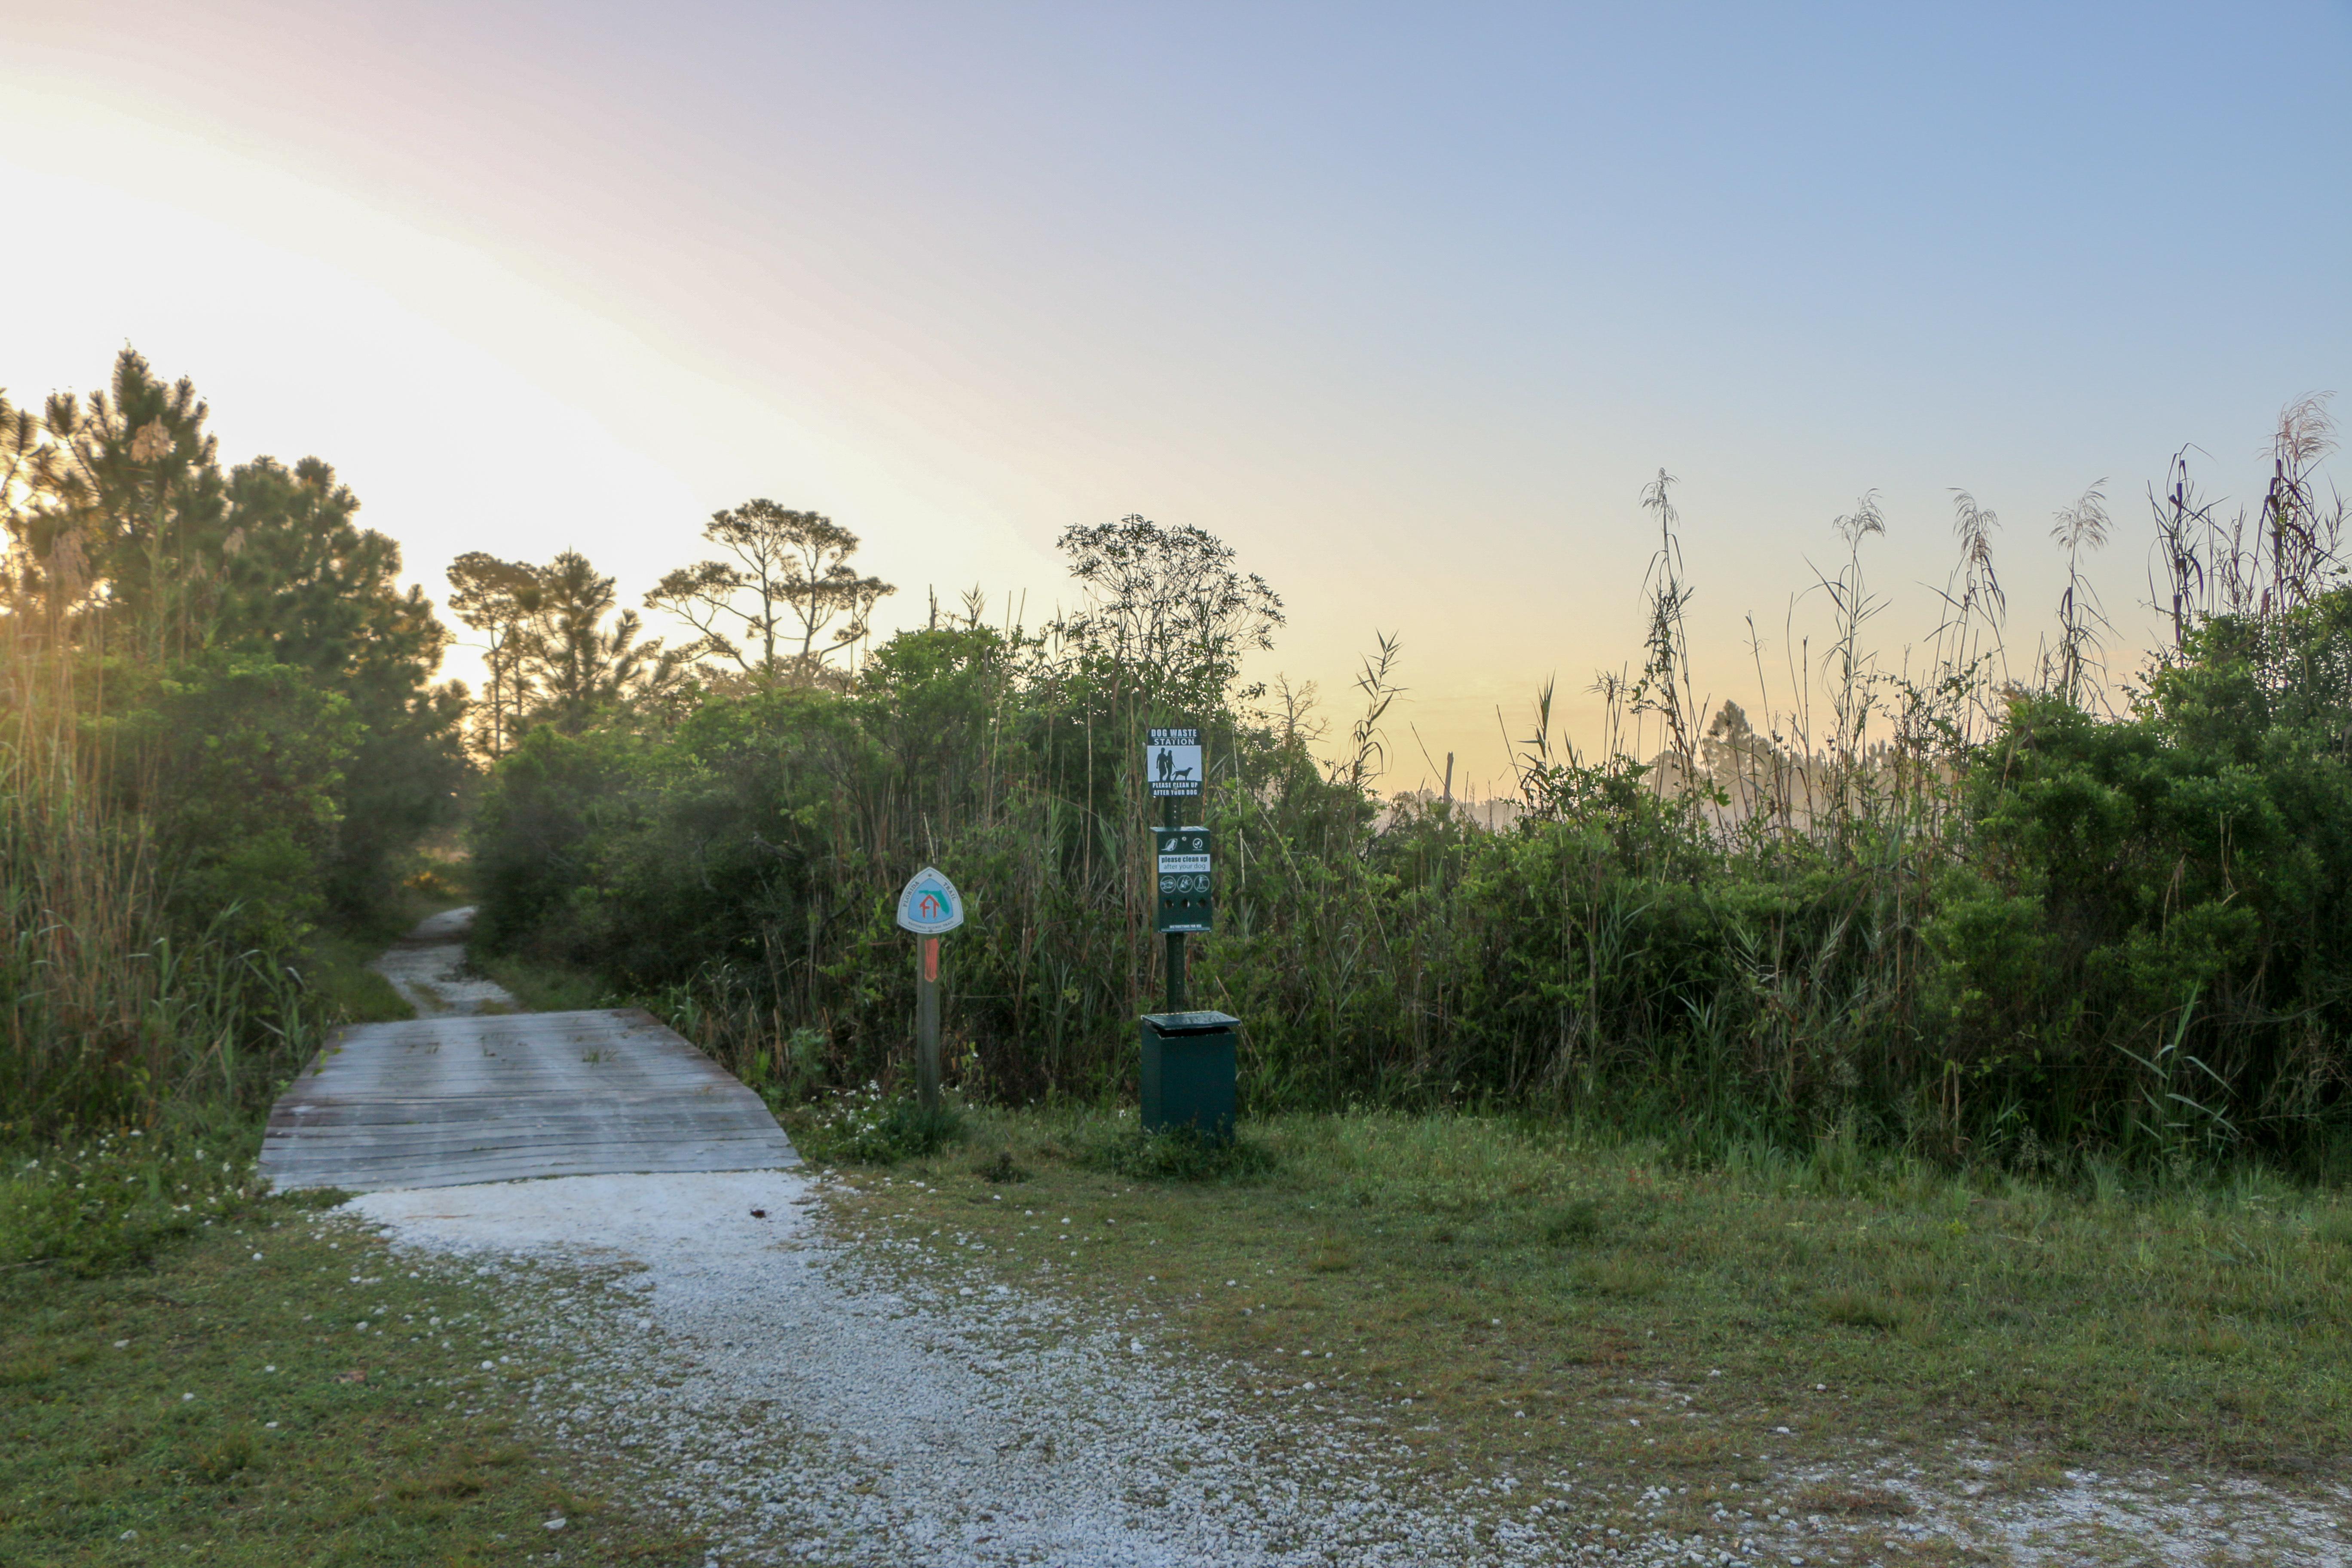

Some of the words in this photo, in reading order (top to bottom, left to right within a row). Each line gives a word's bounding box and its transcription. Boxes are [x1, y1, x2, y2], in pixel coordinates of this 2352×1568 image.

[1151, 729, 1167, 737] DOG
[903, 881, 920, 907] FLORIDA
[943, 882, 957, 901] TRAIL
